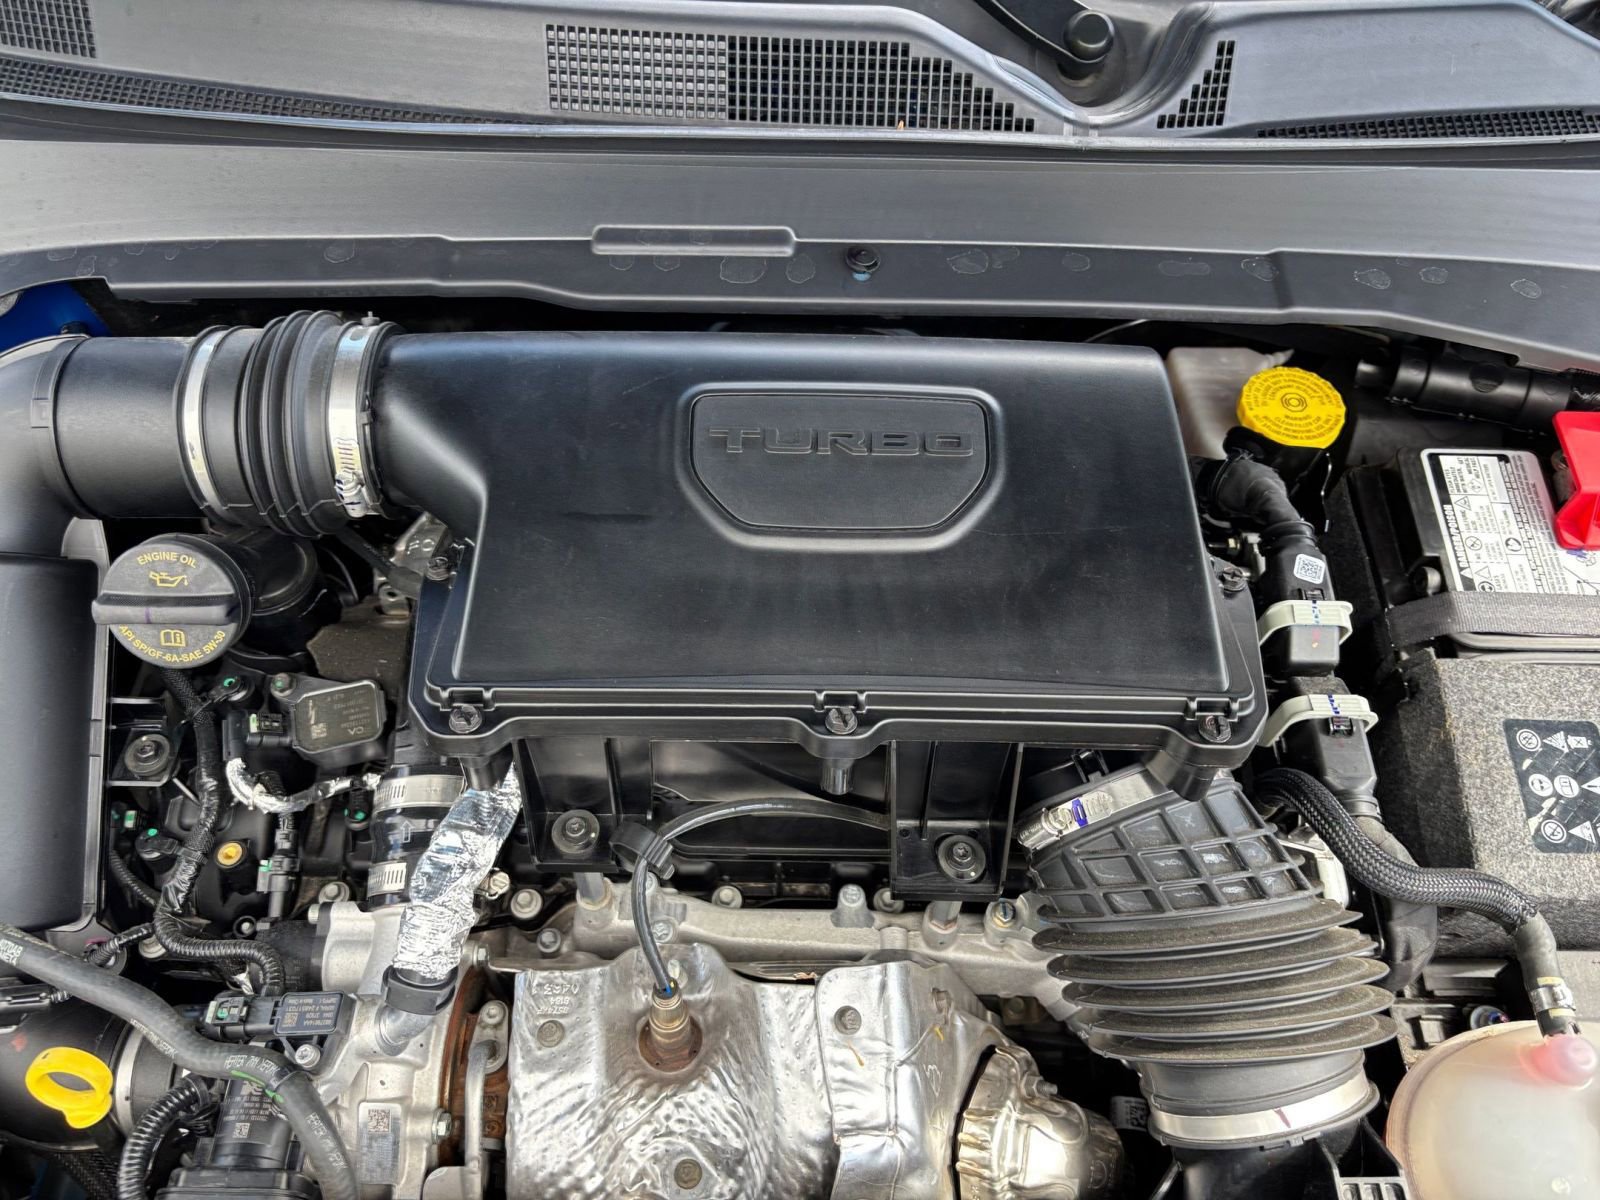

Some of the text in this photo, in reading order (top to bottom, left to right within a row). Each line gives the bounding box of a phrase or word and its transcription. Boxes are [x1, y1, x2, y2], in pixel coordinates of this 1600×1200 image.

[708, 426, 974, 457] TURBO
[137, 552, 197, 568] ENGINE OIL
[119, 624, 134, 643] API
[204, 630, 226, 655] 5W-30
